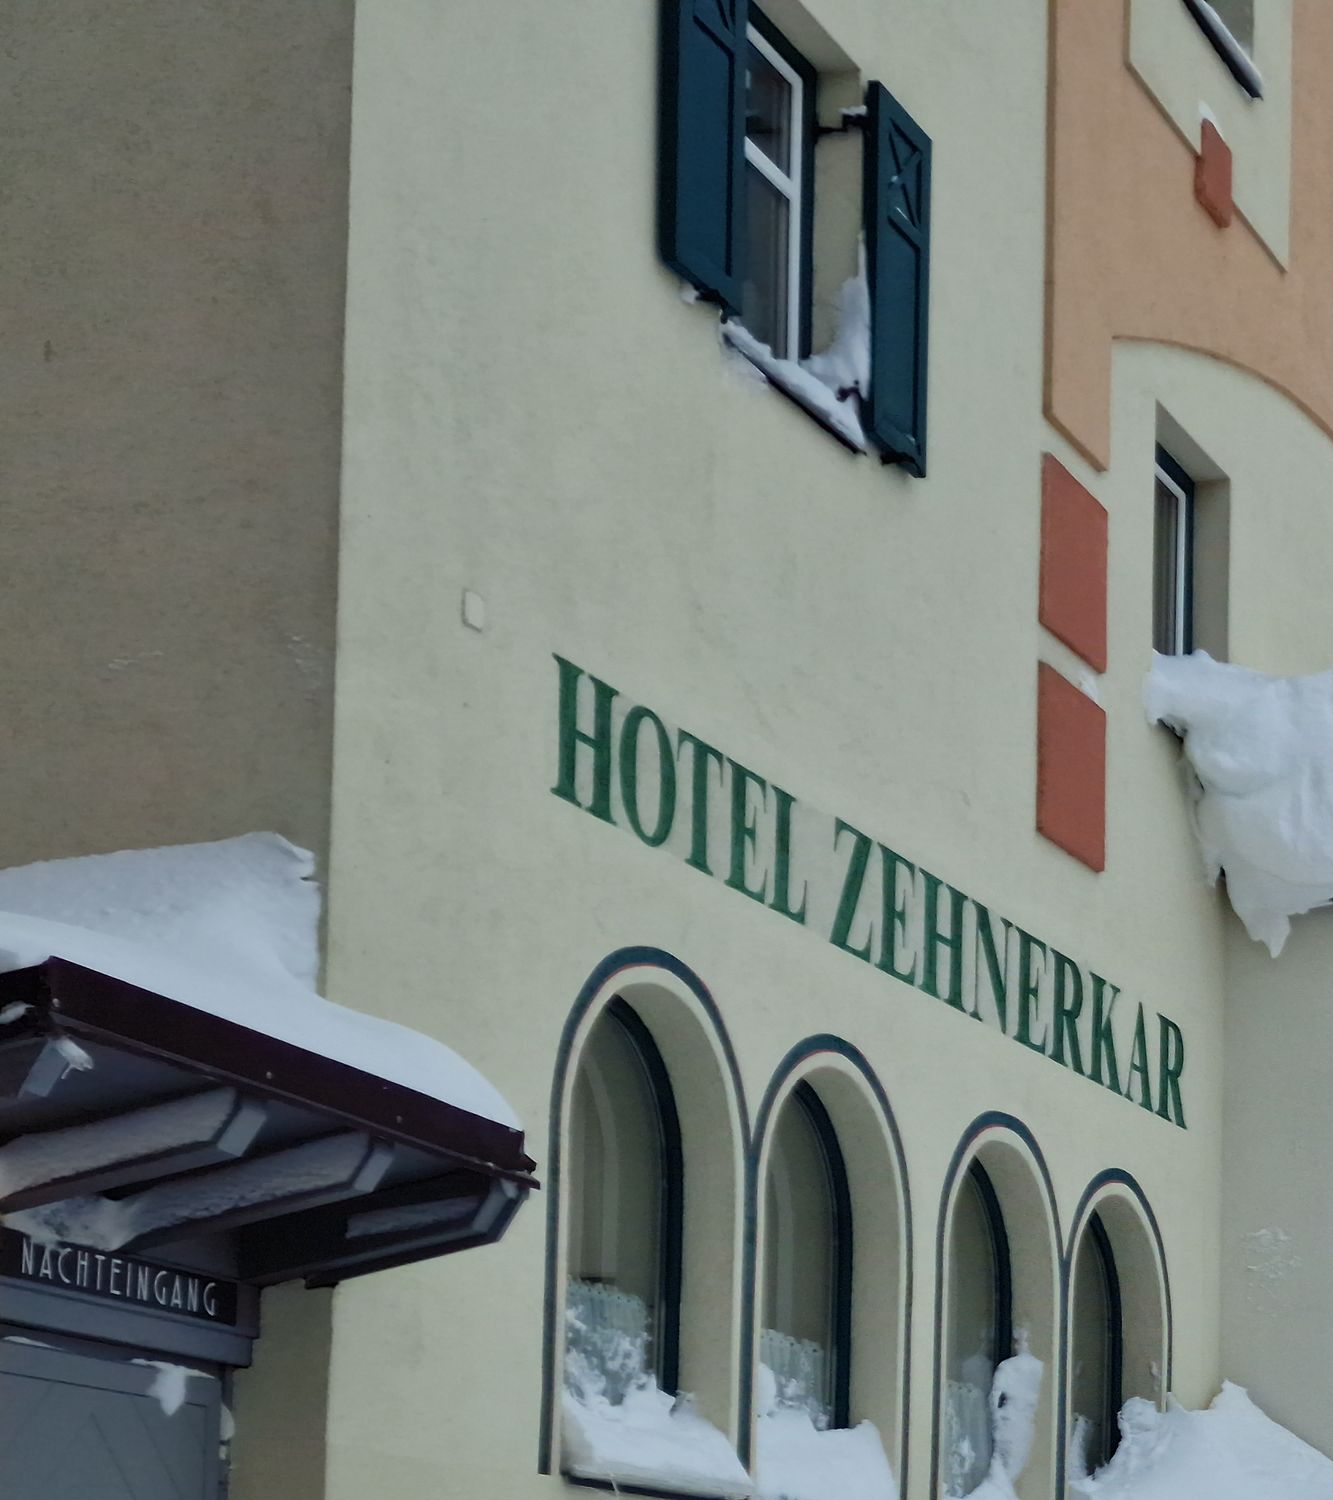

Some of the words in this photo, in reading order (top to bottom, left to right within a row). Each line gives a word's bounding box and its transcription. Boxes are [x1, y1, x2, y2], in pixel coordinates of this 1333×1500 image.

[550, 653, 806, 926] HOTEL
[829, 816, 1187, 1130] ZEHNERKAR
[21, 1236, 217, 1317] NACHTEINGANG
